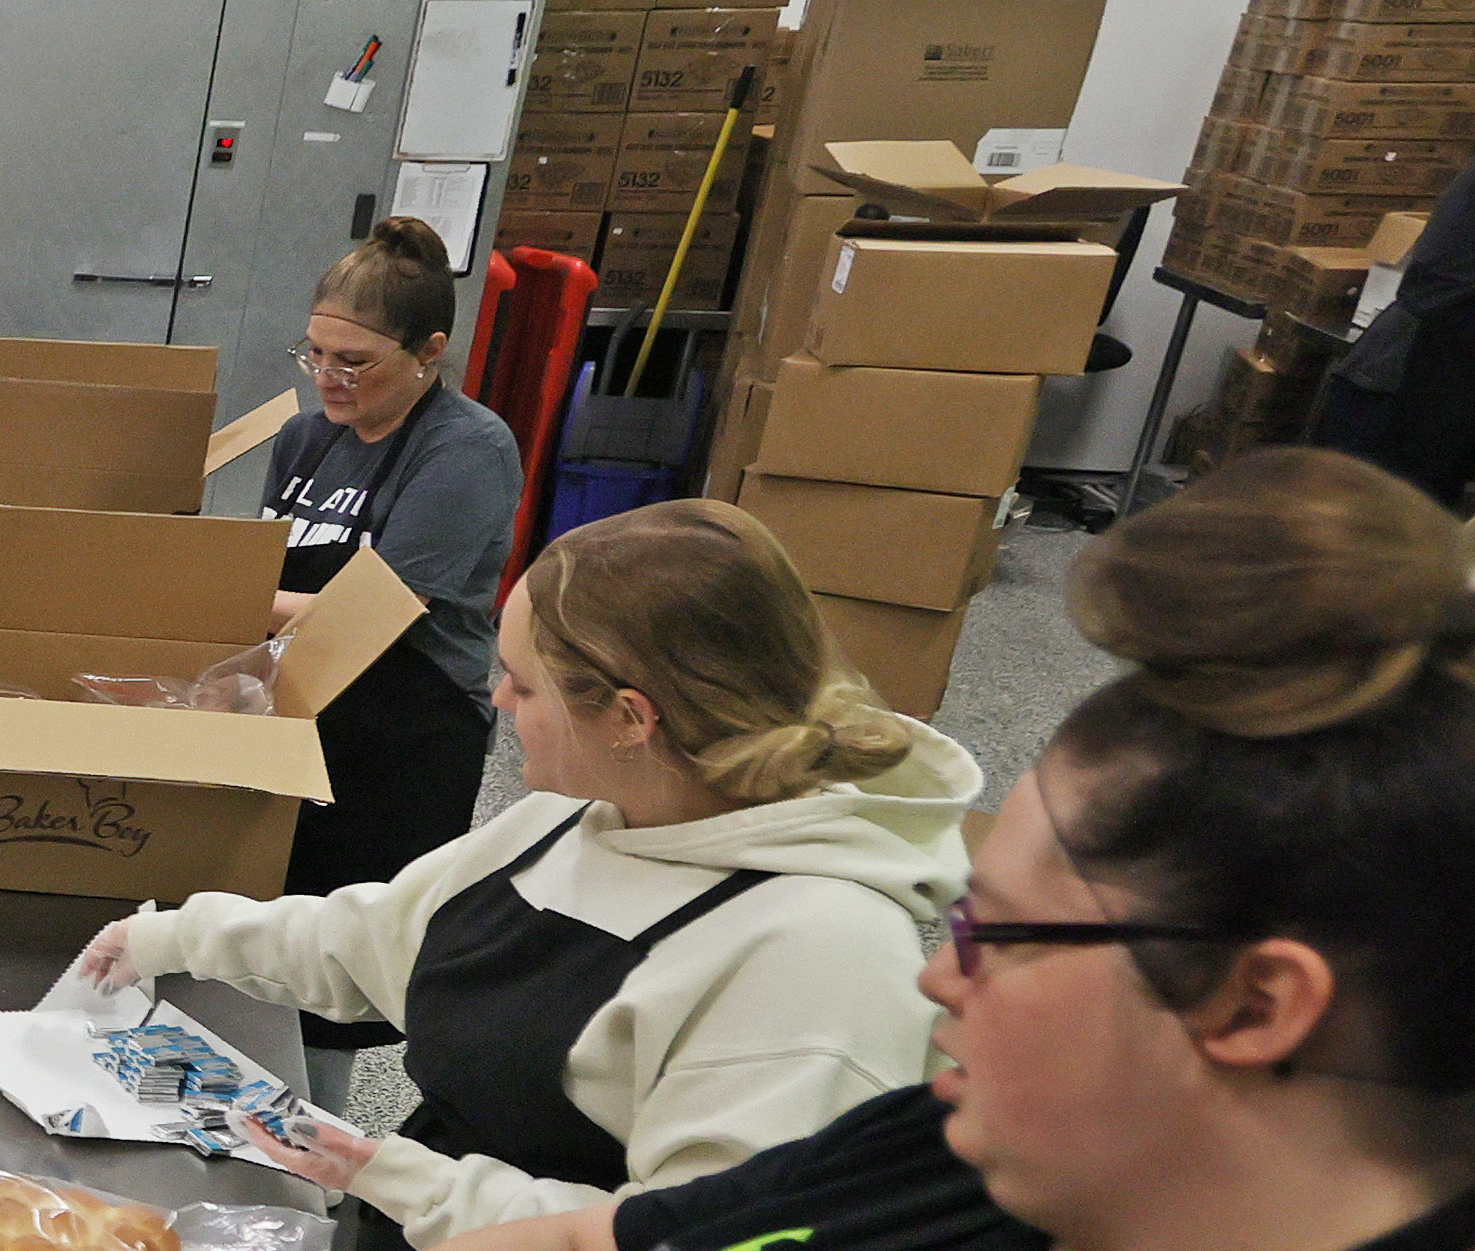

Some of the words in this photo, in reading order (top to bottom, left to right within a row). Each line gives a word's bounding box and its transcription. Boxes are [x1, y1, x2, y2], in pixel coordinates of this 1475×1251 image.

[529, 77, 551, 90] 32
[640, 70, 684, 88] 5132
[508, 174, 531, 190] 32
[617, 171, 661, 188] 5132
[90, 799, 153, 858] Boy
